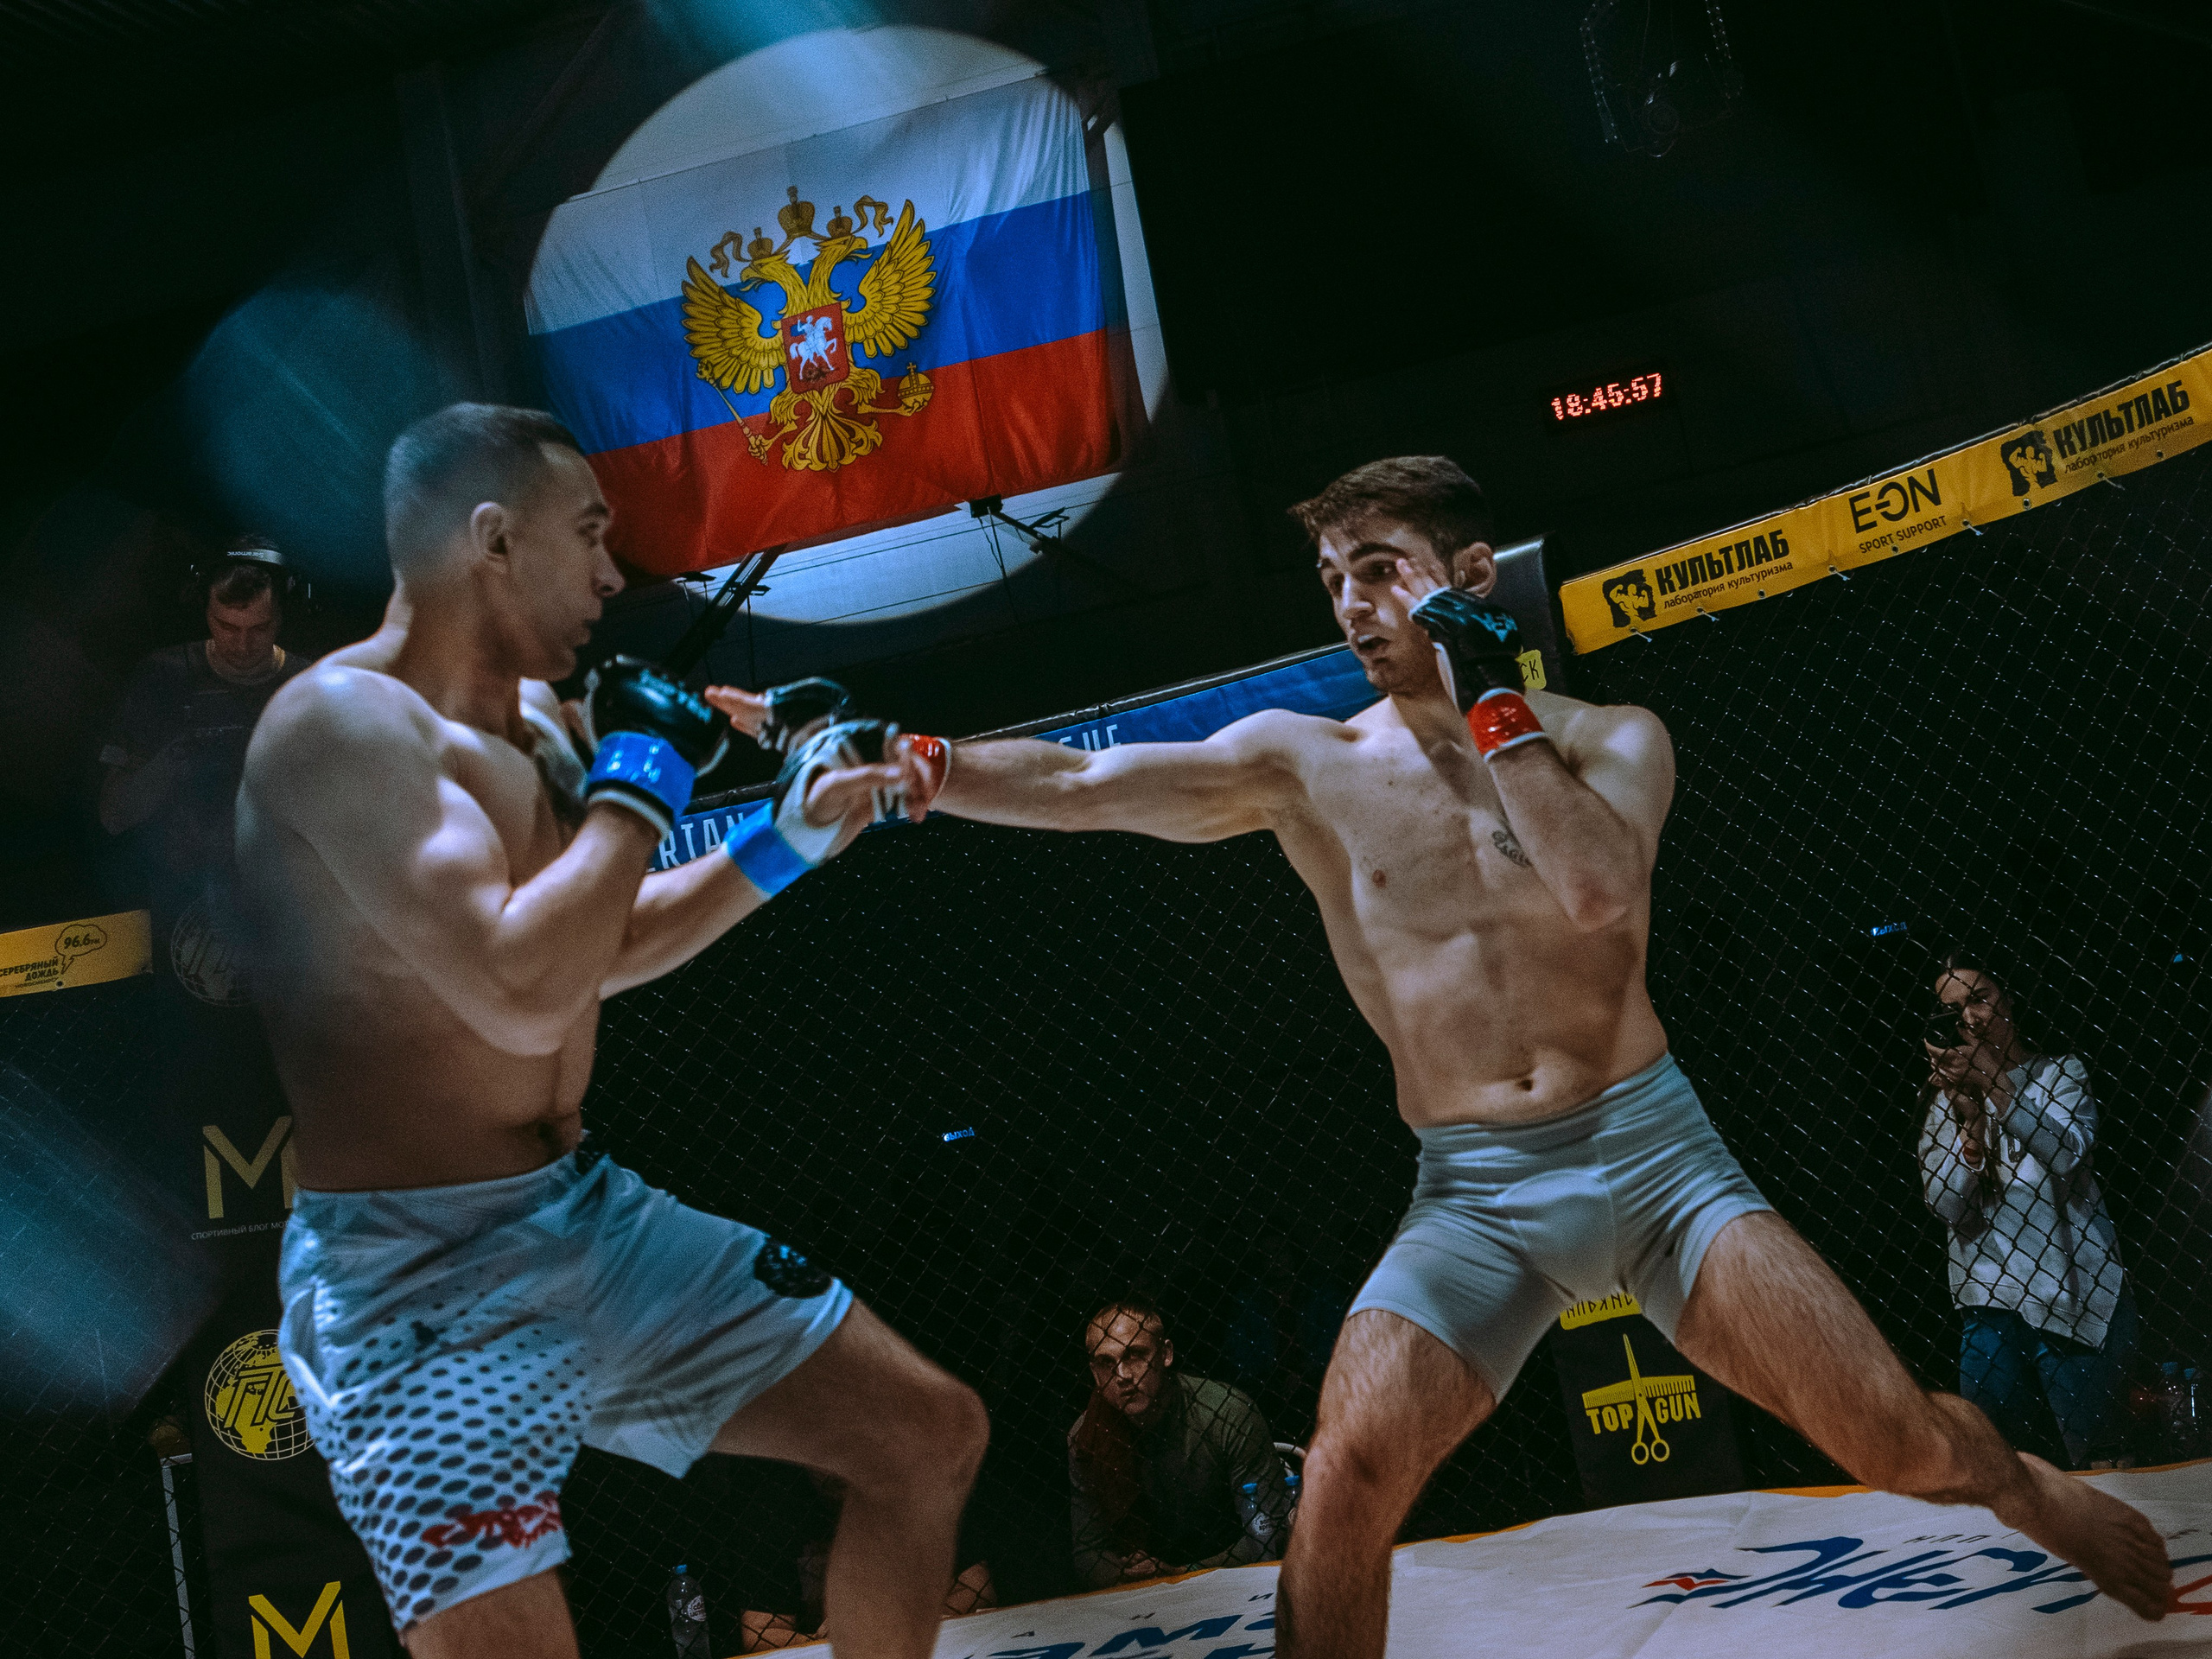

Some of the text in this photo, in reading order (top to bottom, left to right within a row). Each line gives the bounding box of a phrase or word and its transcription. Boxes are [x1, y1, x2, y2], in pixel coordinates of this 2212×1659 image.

[1551, 372, 1662, 421] 18:45:57
[2053, 379, 2190, 459] КУЛЬТЛАБ
[2064, 416, 2194, 474] лабортория культуризма
[1859, 516, 1948, 554] SPORT SUPPORT
[1655, 529, 1789, 596] КУЛЬТЛАБ
[1664, 562, 1794, 609] лаборатория культуризма
[24, 968, 60, 982] ДОЖДЬ
[191, 1224, 248, 1241] СПОРТИВНЫЙ
[249, 1223, 269, 1231] БЛОГ
[1586, 1391, 1701, 1435] TOP GUN
